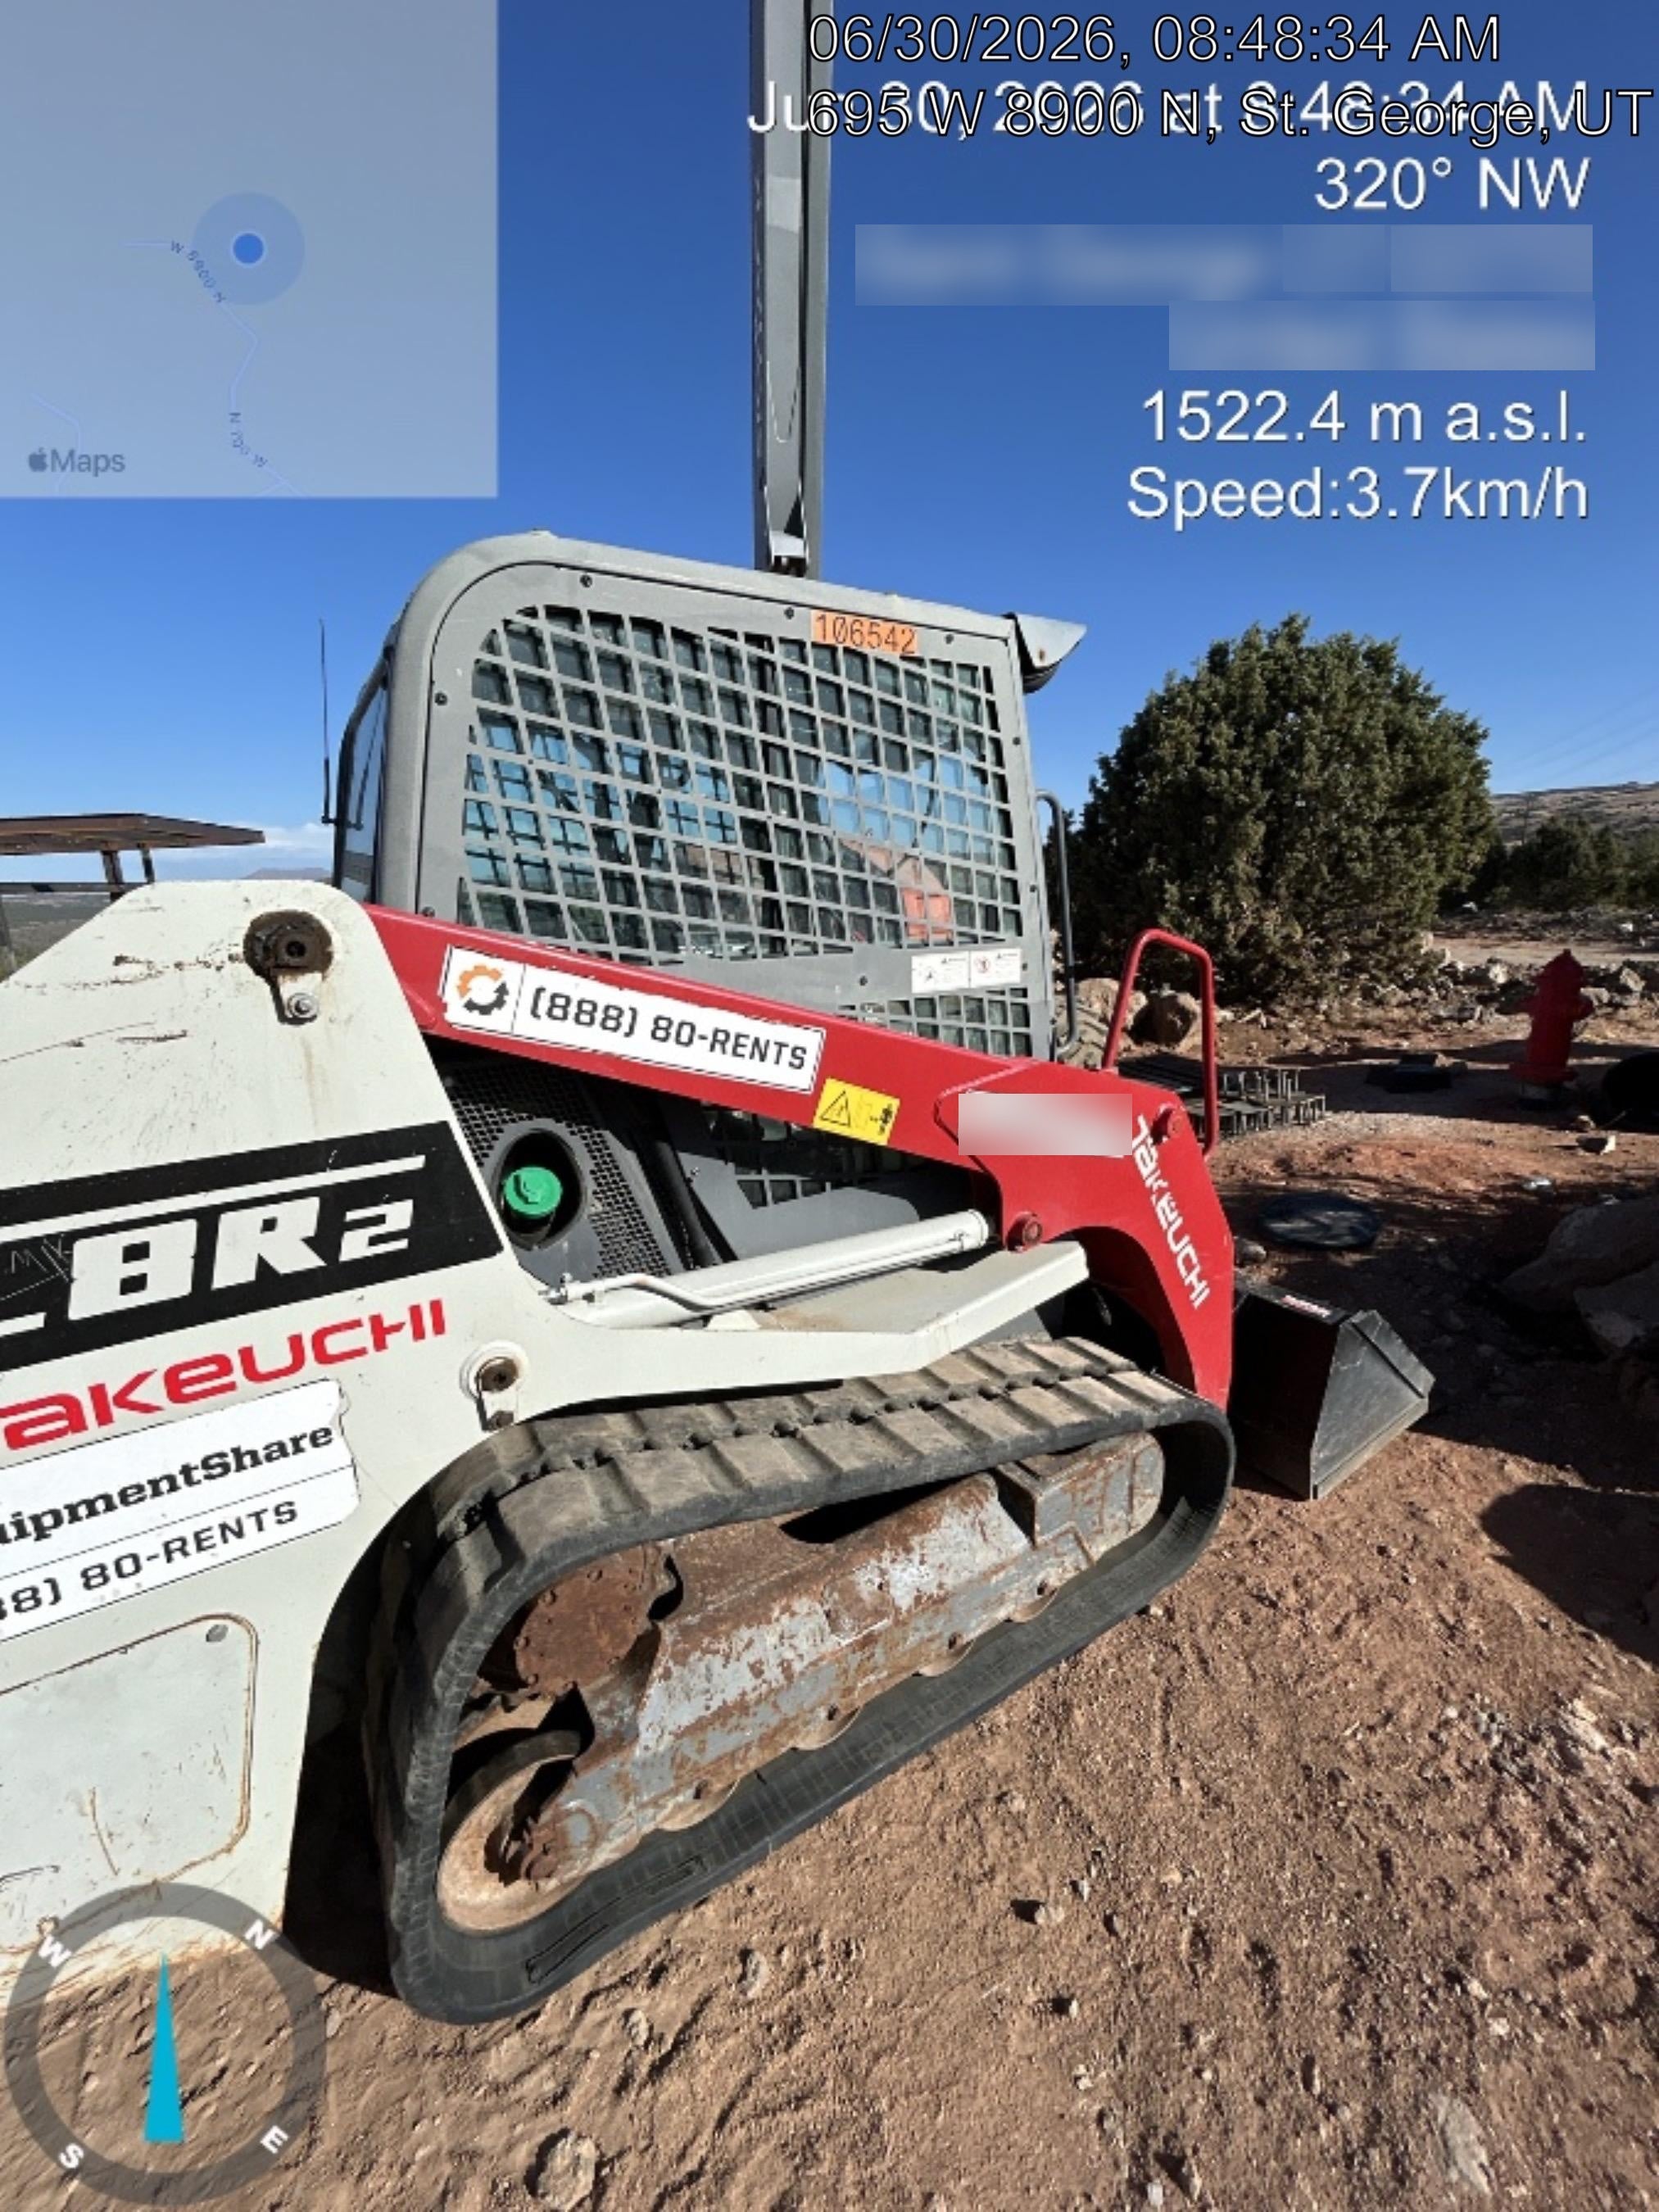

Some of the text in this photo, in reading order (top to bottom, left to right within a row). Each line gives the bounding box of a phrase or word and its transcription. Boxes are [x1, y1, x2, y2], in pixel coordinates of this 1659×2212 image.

[816, 614, 917, 655] 106542
[530, 986, 807, 1070] (888) 80-RENTS
[0, 1196, 413, 1338] 8R2
[0, 1500, 298, 1620] 8) 80-RENTS
